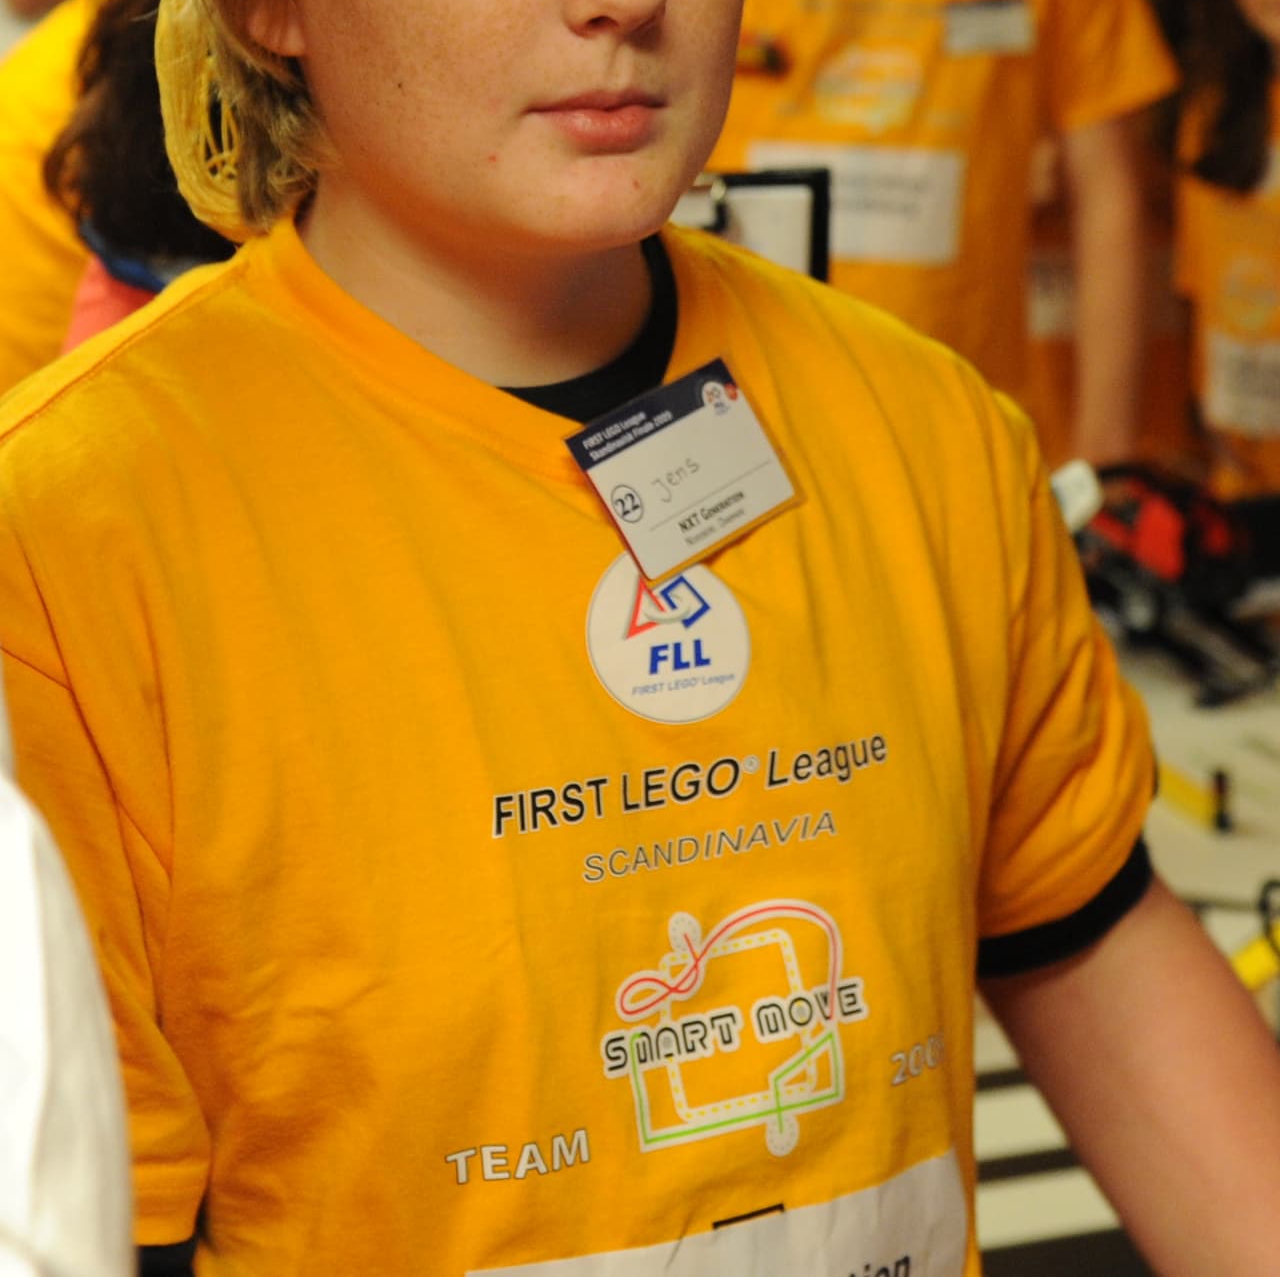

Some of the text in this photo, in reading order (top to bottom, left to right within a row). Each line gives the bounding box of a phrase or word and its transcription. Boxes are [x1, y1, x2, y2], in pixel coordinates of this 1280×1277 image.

[602, 424, 622, 440] LEGO
[615, 492, 640, 517] 22
[678, 513, 700, 534] NXT
[649, 639, 711, 675] FLL
[631, 682, 665, 696] FIRST
[493, 777, 609, 837] FIRST
[767, 733, 887, 788] League
[583, 811, 836, 882] SCANDINAVIA
[605, 983, 862, 1072] SMART MOVE
[445, 1128, 591, 1185] TEAM
